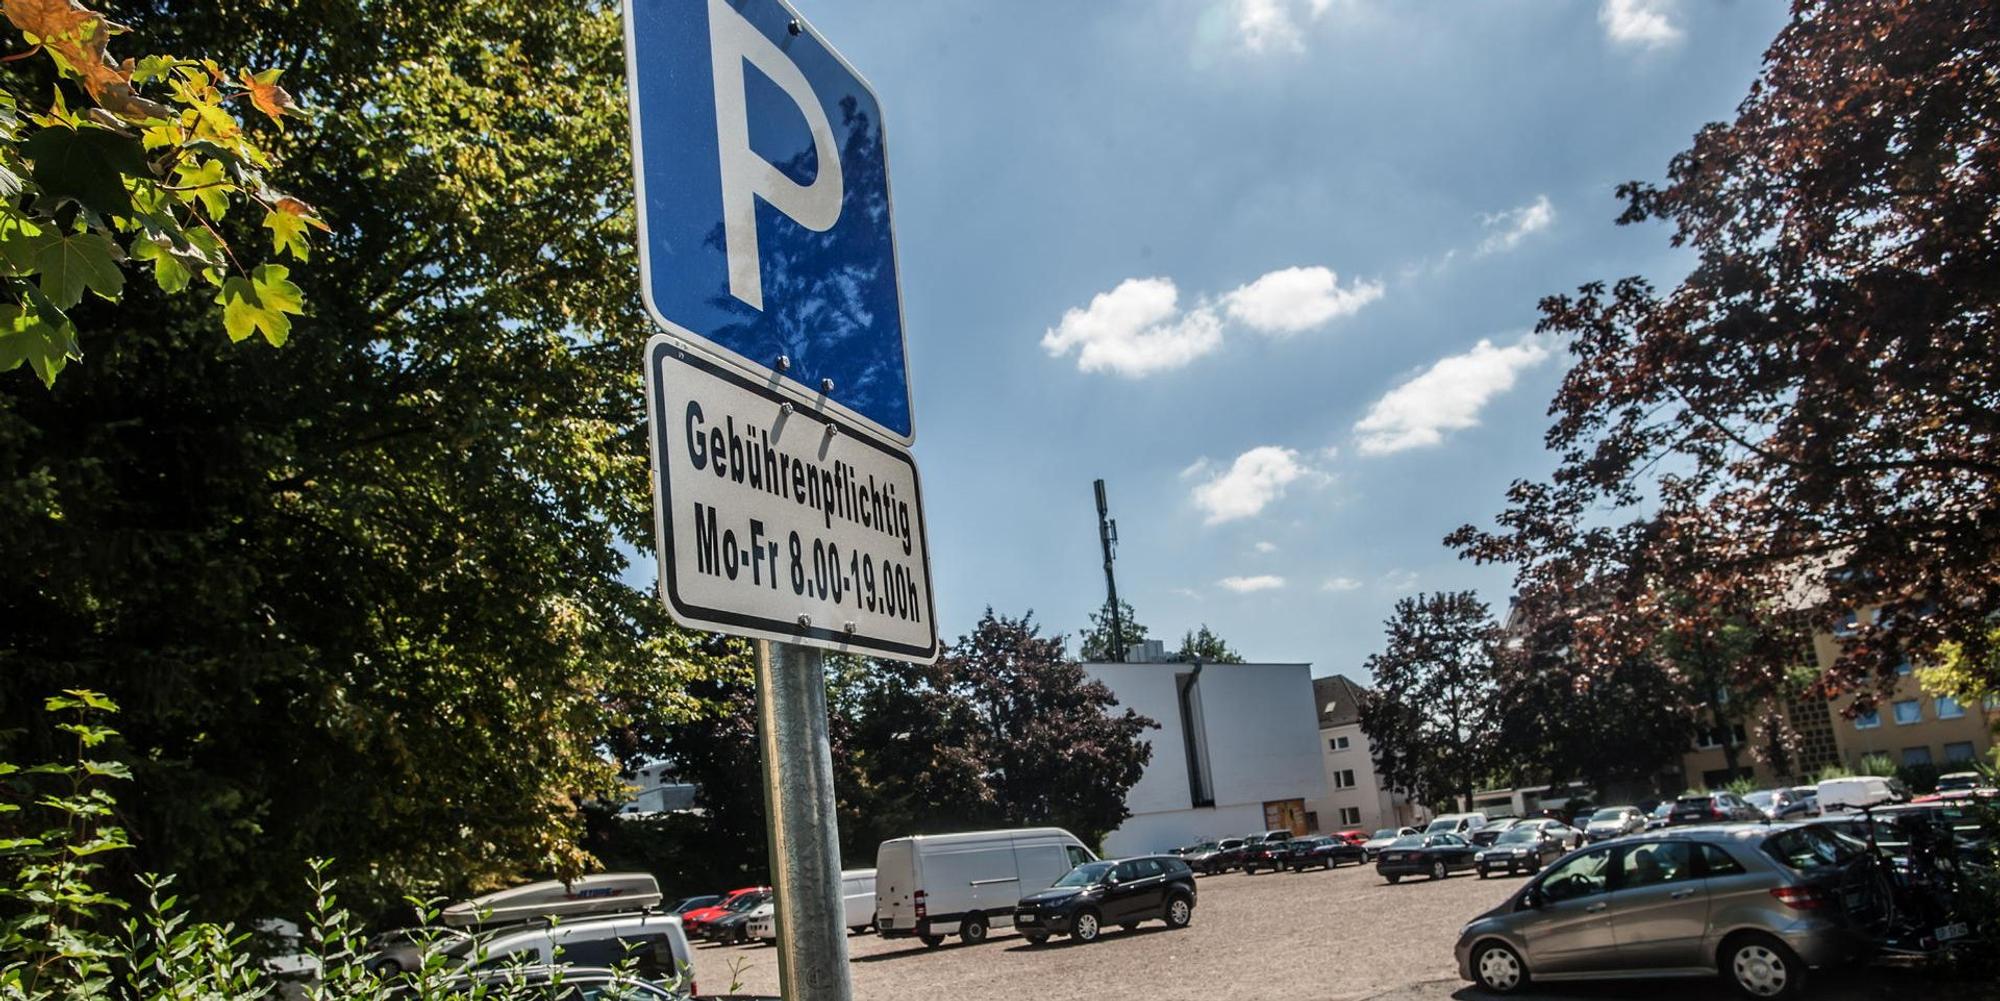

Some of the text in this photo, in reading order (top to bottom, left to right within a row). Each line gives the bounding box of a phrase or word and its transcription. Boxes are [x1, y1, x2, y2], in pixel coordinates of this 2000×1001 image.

[708, 0, 844, 312] P
[686, 400, 912, 556] Gebührenpflichtig
[694, 502, 921, 623] Mo-Fr 8.00-19.00h
